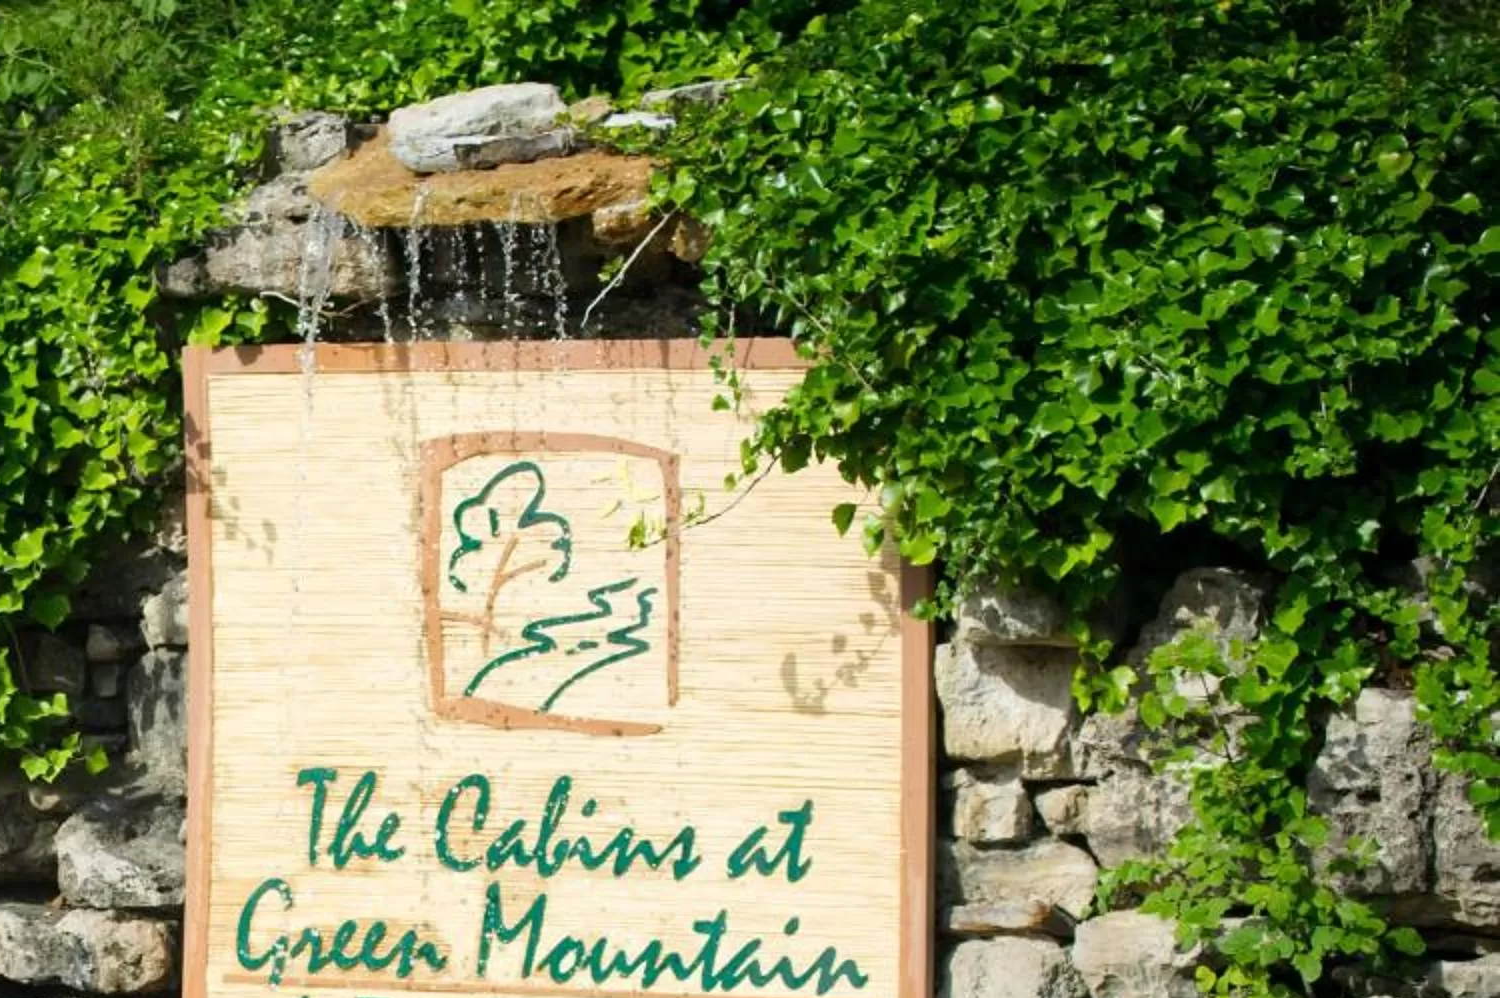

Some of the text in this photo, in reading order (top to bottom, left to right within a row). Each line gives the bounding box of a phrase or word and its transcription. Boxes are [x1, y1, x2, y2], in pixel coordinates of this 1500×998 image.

[297, 767, 814, 881] The Cabins at
[236, 878, 868, 994] Green Mountain
